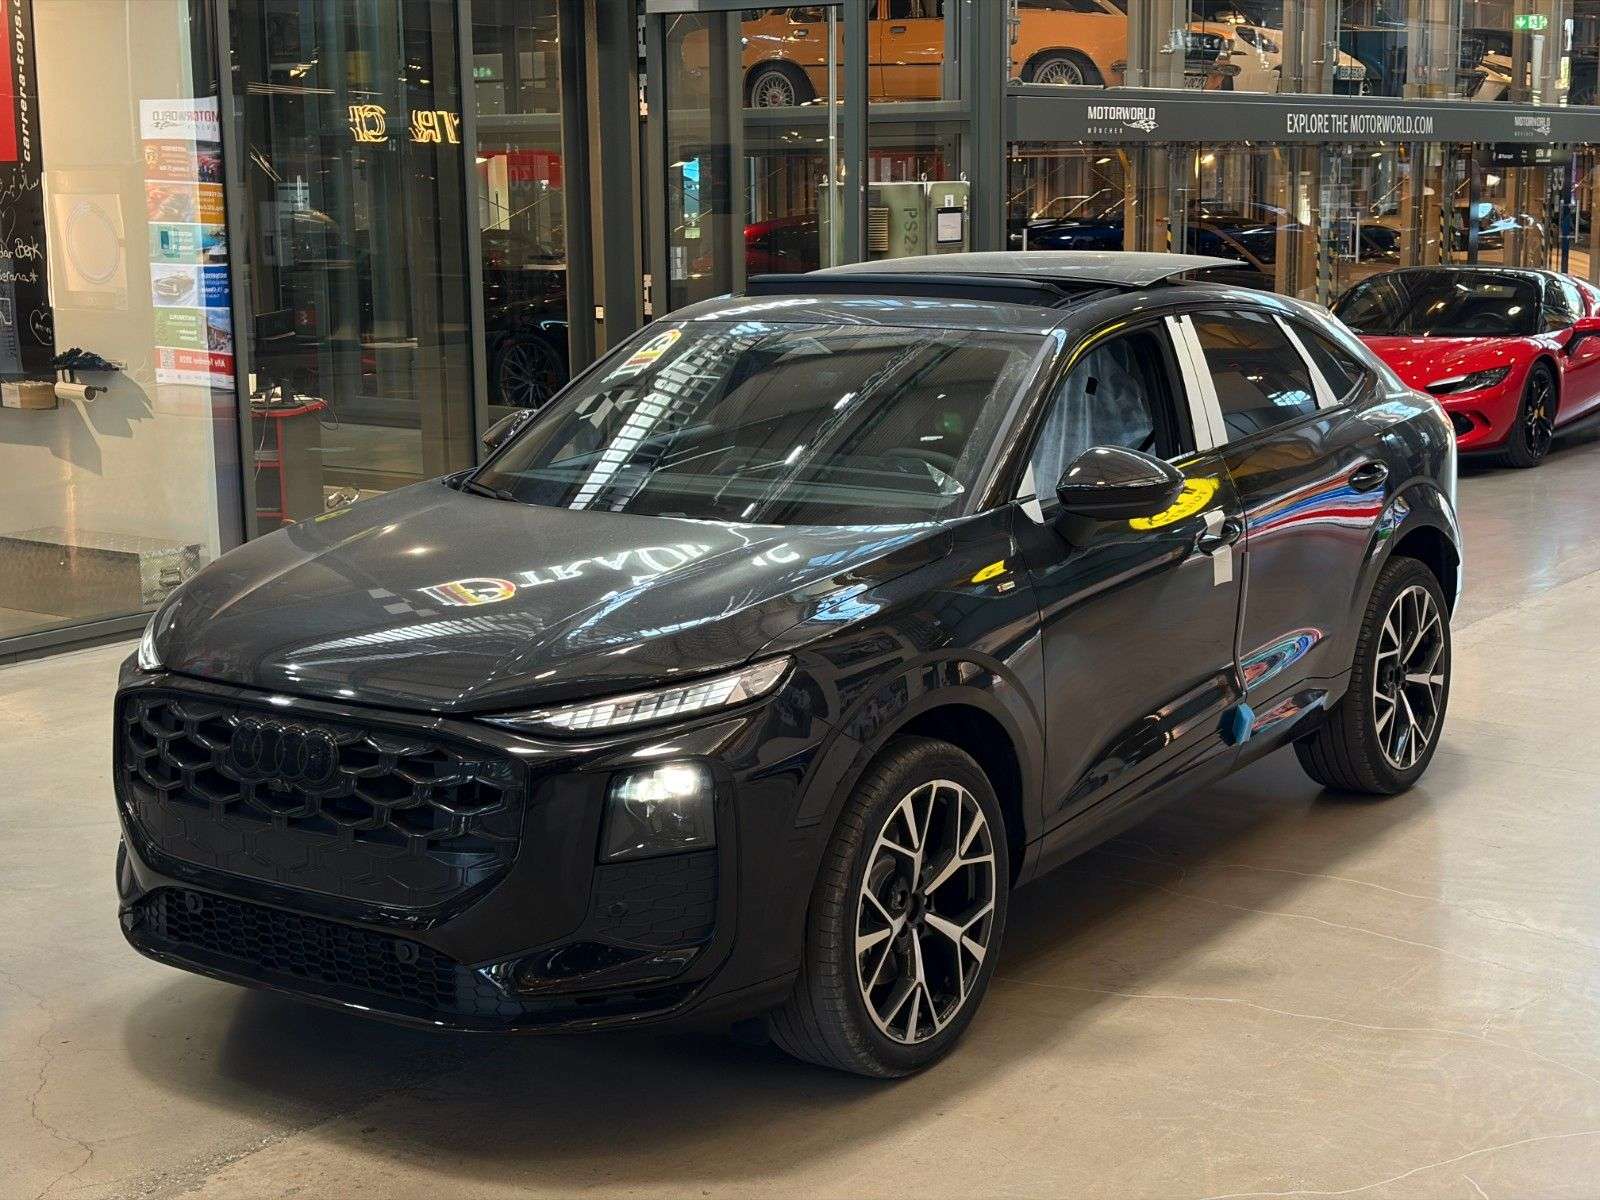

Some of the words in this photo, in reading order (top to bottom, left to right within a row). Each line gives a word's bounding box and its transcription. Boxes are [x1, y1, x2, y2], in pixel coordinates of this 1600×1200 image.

[1087, 106, 1156, 120] MOTORWORLD
[1287, 113, 1330, 134] EXPLORE
[1331, 114, 1348, 134] THE
[1350, 115, 1434, 135] MOTORWORLD.COM
